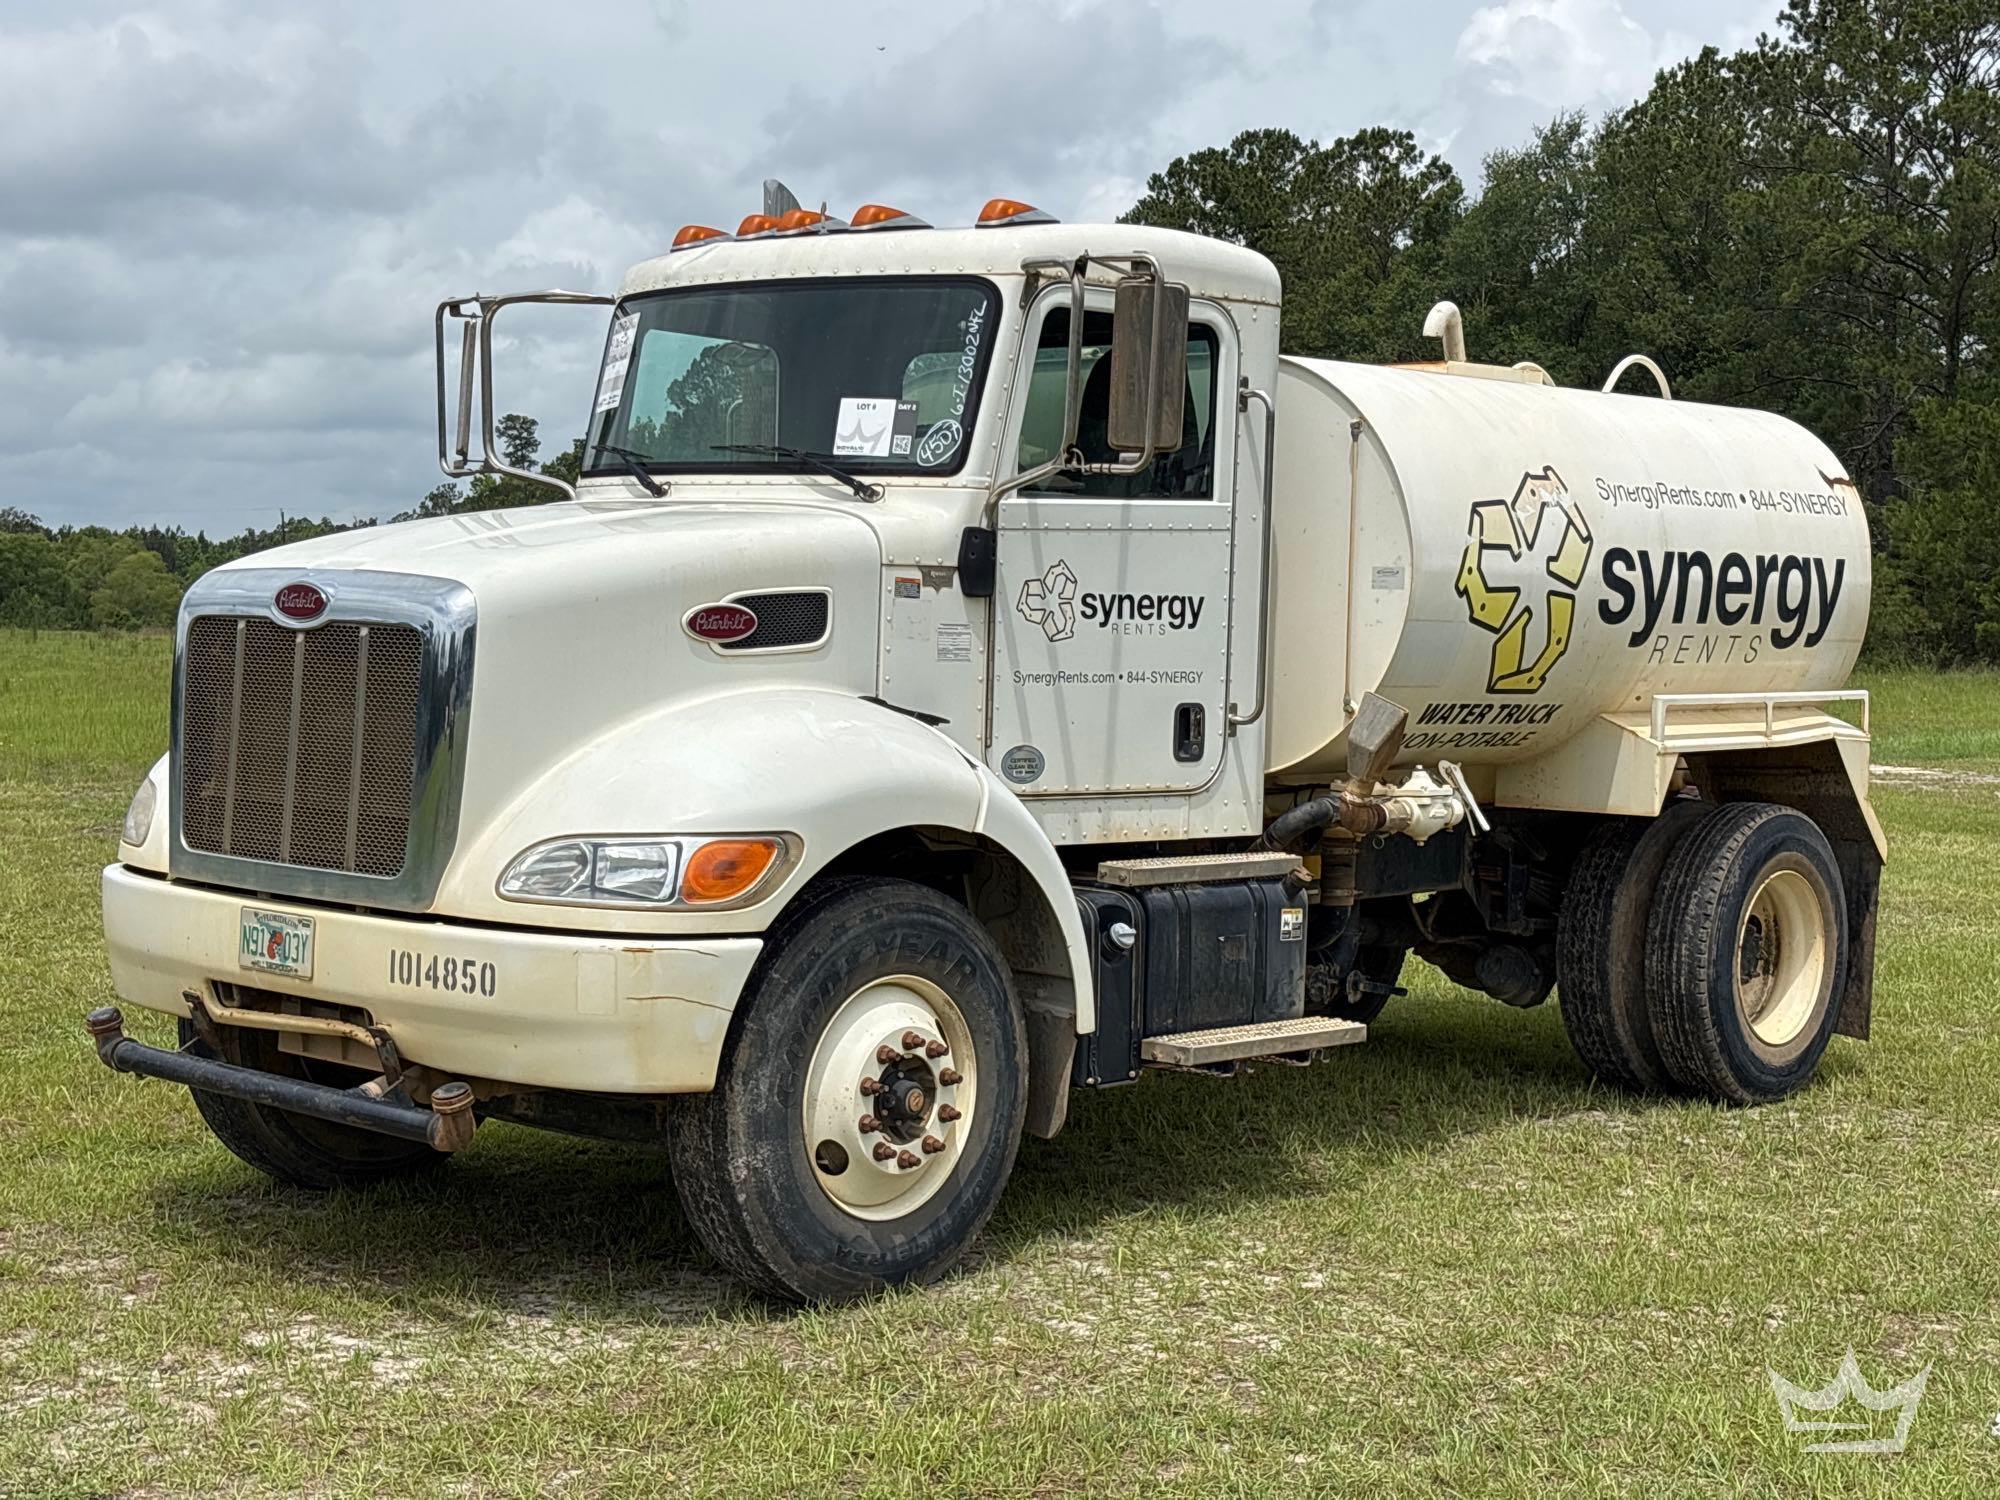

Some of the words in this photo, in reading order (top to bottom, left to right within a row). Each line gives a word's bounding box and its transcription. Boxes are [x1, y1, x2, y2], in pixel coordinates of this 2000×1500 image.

[856, 403, 873, 411] LOT
[1595, 477, 1738, 509] SynergyRents.com
[1749, 489, 1849, 517] 844-SYNERGY
[1080, 592, 1205, 630] synergy
[1597, 547, 1846, 650] synergy
[695, 612, 751, 632] Peterbilt
[1111, 623, 1166, 636] RENTS
[1648, 635, 1763, 664] RENTS
[1012, 670, 1115, 687] SynergyRents.com
[1126, 671, 1204, 684] 844-SYNERGY
[1416, 703, 1494, 725] WATER
[1489, 703, 1564, 725] TRUCK
[389, 948, 497, 998] 1014850
